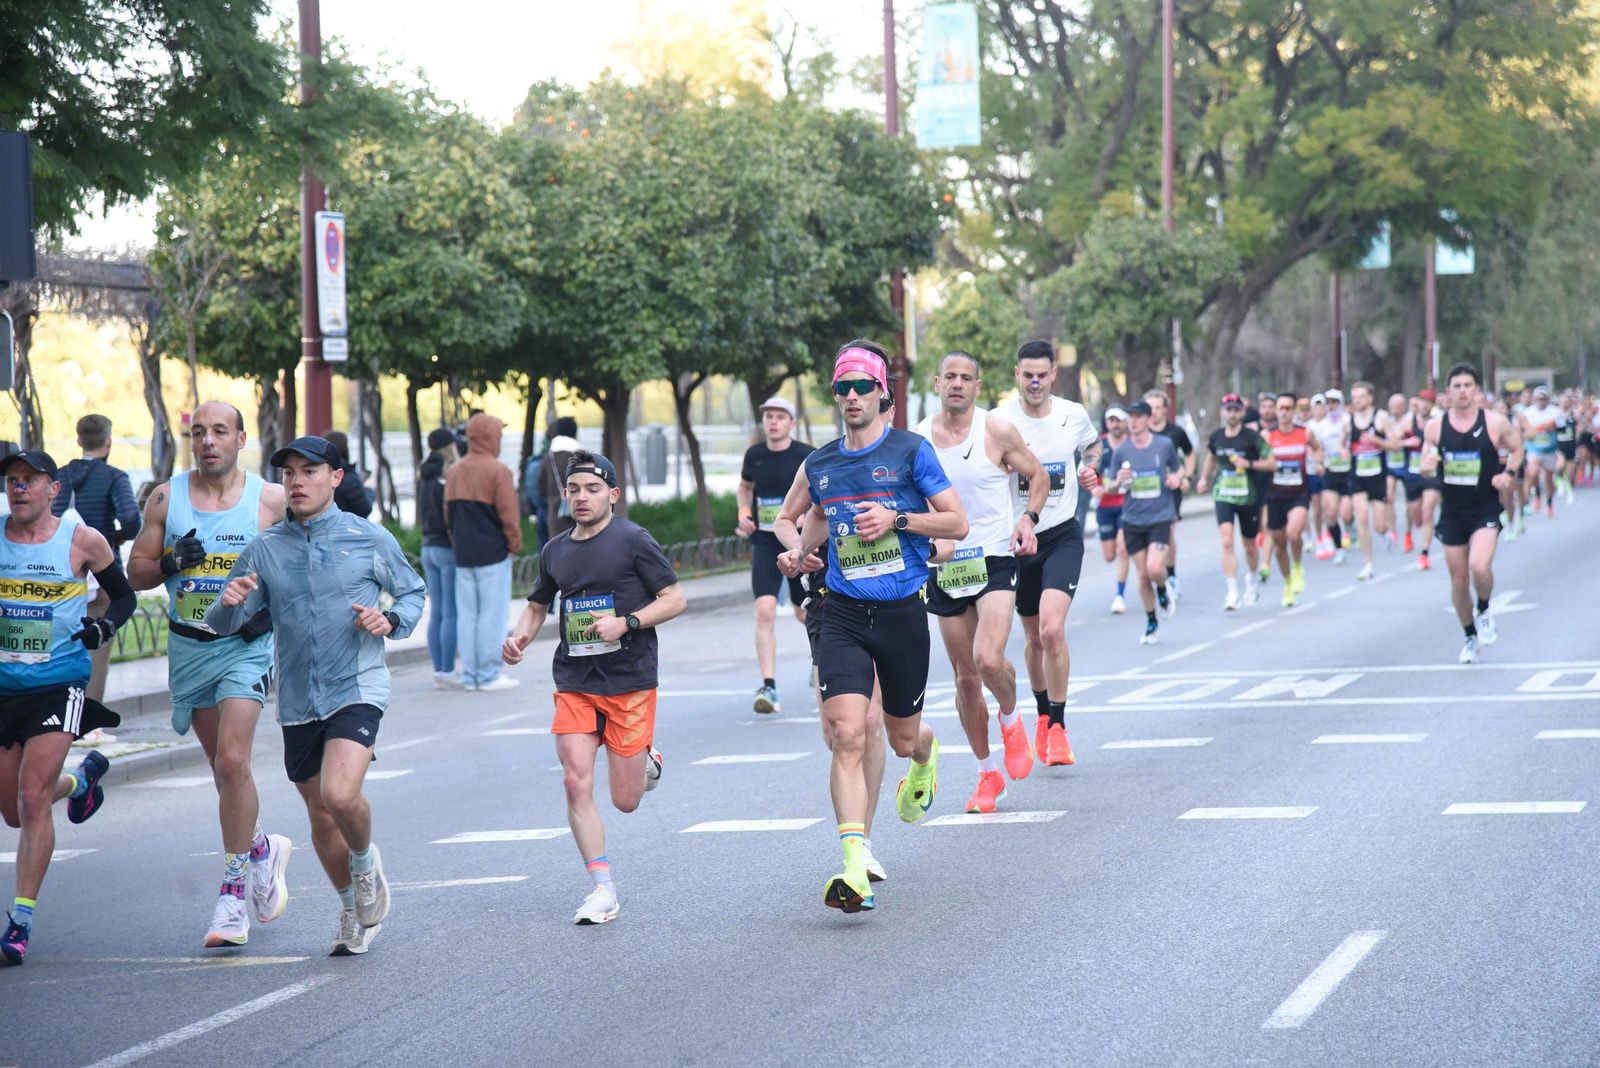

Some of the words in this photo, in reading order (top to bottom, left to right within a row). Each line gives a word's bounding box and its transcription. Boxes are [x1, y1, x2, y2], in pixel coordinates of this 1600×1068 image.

[216, 535, 245, 543] CURVA
[840, 554, 866, 568] NOAH
[870, 547, 902, 563] ROMA
[954, 550, 978, 560] URICH
[27, 563, 55, 572] CURVA
[938, 577, 960, 588] TEAM
[961, 572, 988, 585] SMILE
[575, 599, 606, 609] ZURICH
[6, 608, 45, 617] ZURICH
[8, 625, 24, 634] 586
[23, 639, 49, 650] REY
